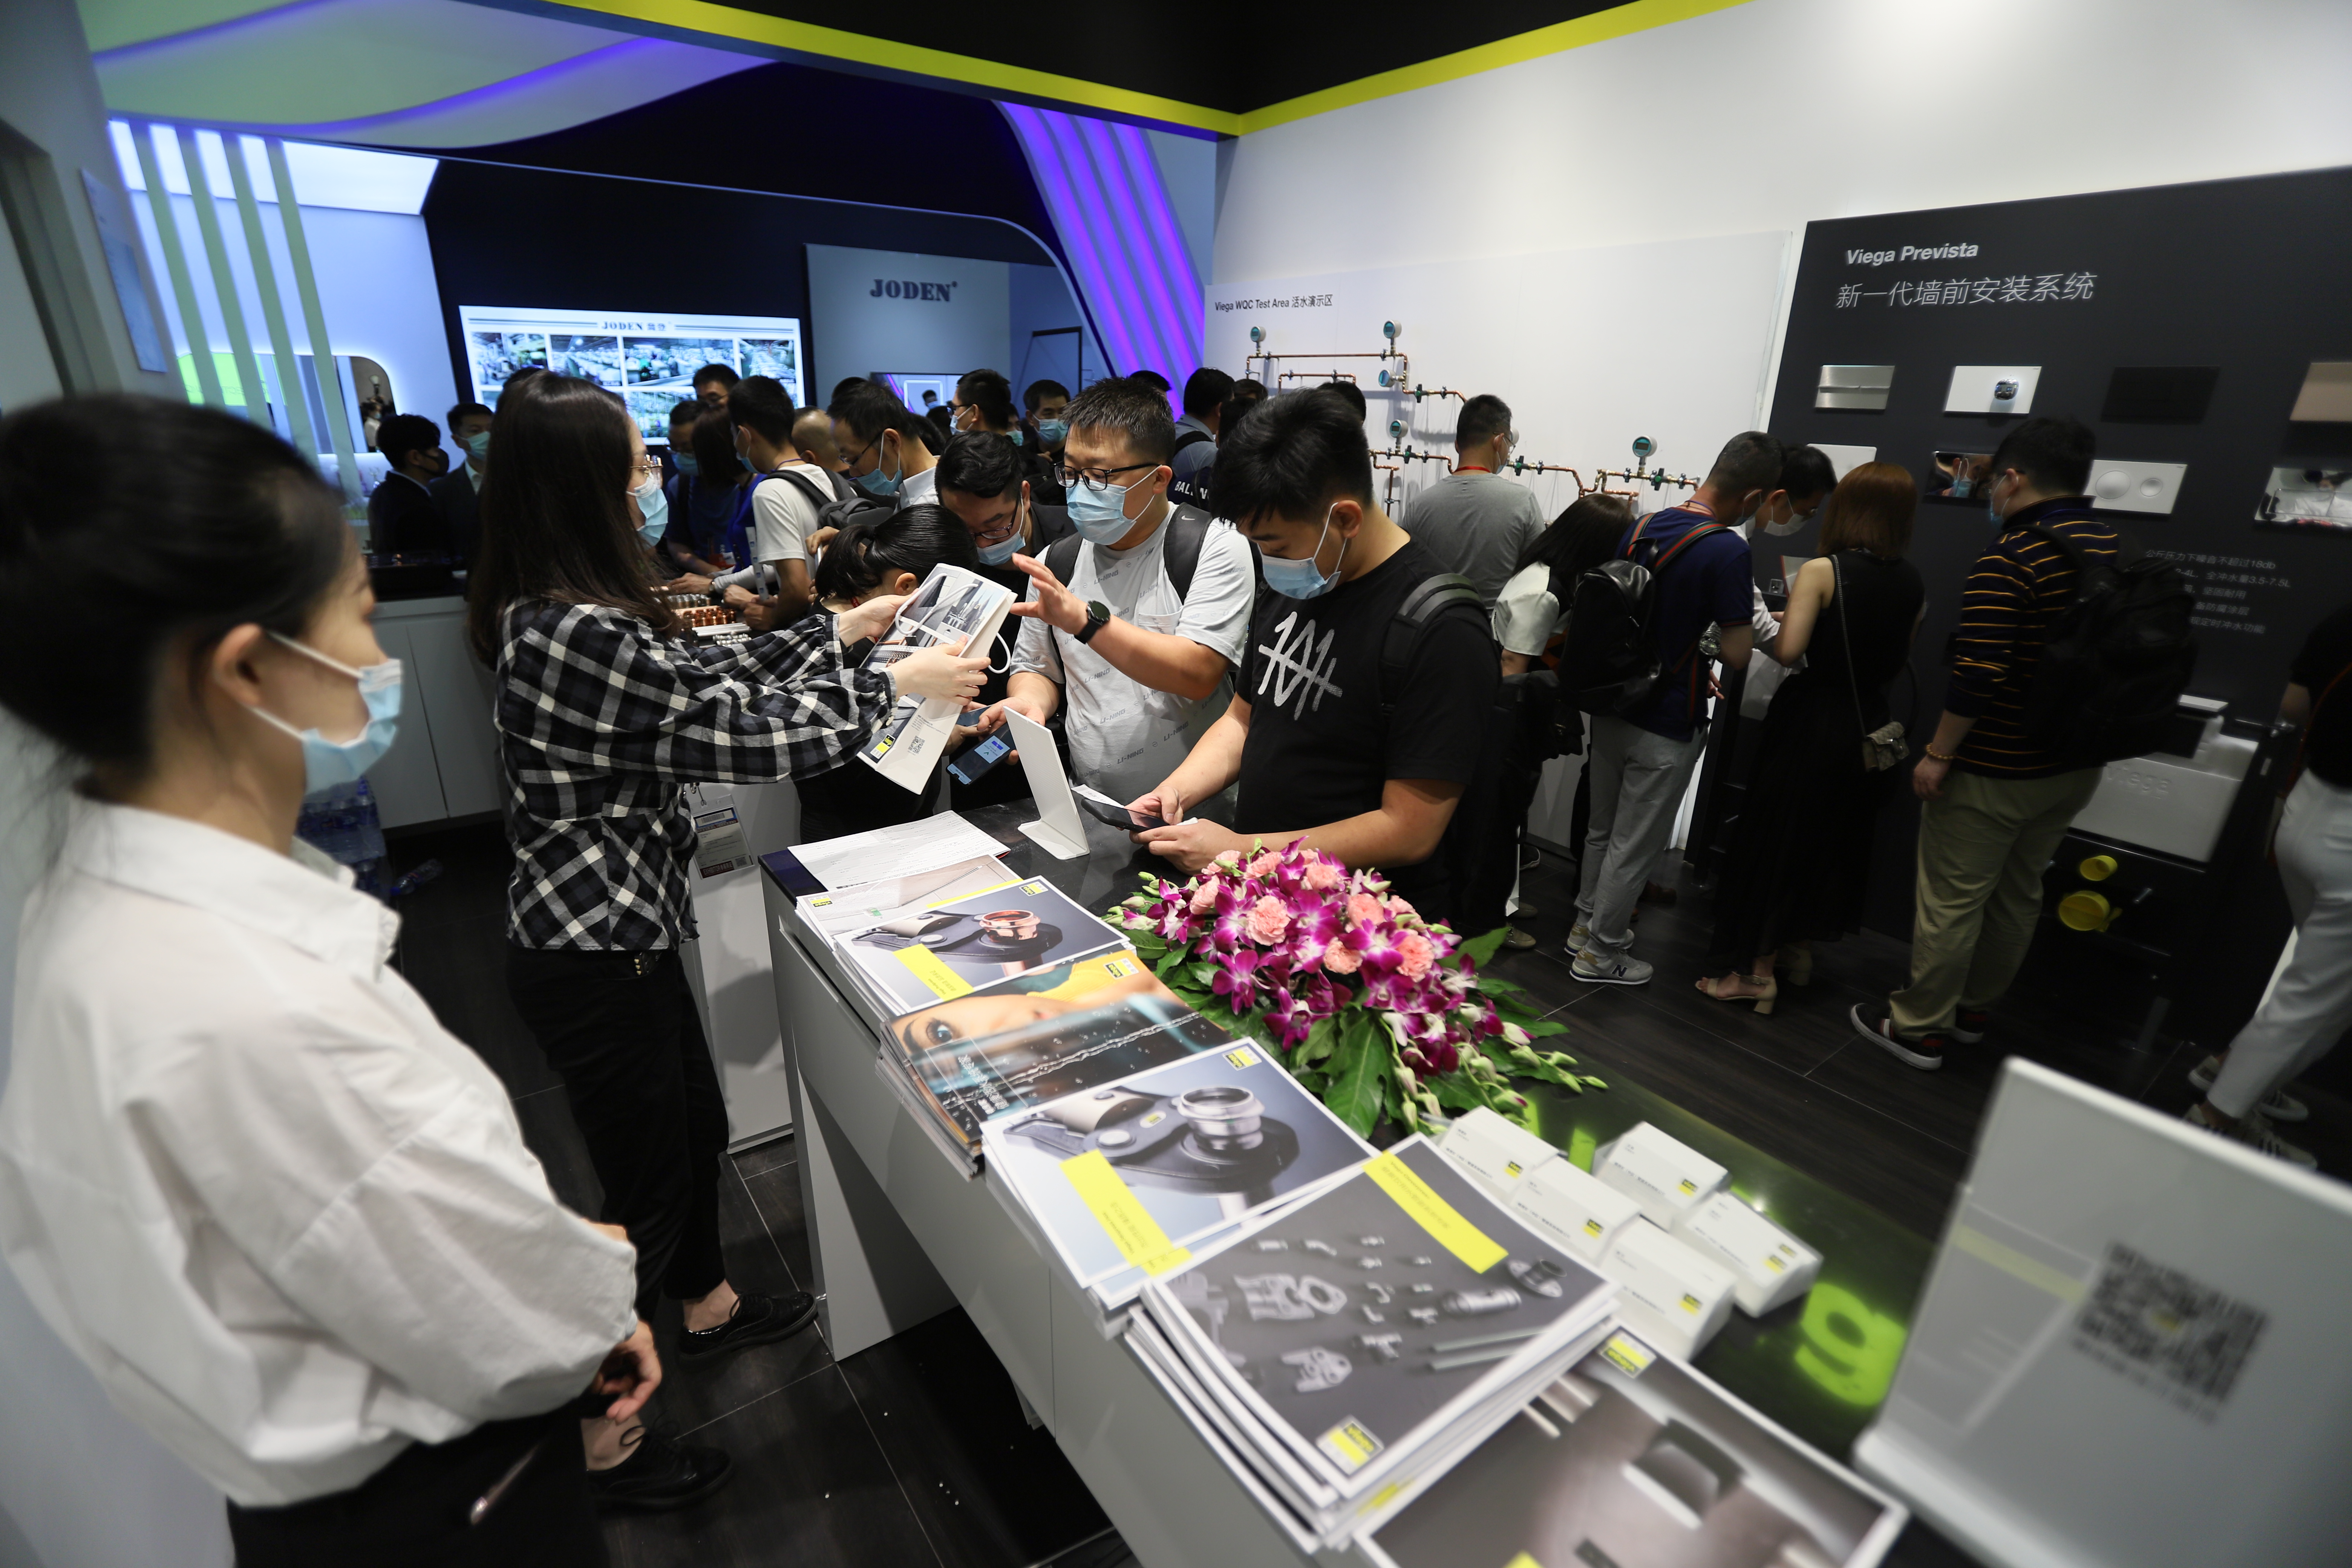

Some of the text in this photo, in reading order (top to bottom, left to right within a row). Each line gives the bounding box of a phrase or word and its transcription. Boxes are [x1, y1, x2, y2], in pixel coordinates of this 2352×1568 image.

[1847, 243, 1979, 266] Viega Prevista
[870, 279, 951, 302] JODEN
[1836, 272, 2097, 309] 新一代墙前安装系统
[1215, 294, 1333, 312] Viega WQC Test Area 活水演示区
[602, 321, 643, 330] JODEN
[1094, 570, 1118, 585] LI-NING
[1084, 668, 1110, 683] LI-NING
[1100, 708, 1126, 724] LI-NING
[1164, 721, 1189, 742] LI-NING
[1117, 747, 1144, 764] LI-NING
[1108, 964, 1121, 977] viega
[1611, 964, 1628, 978] N
[1228, 1054, 1243, 1068] viega
